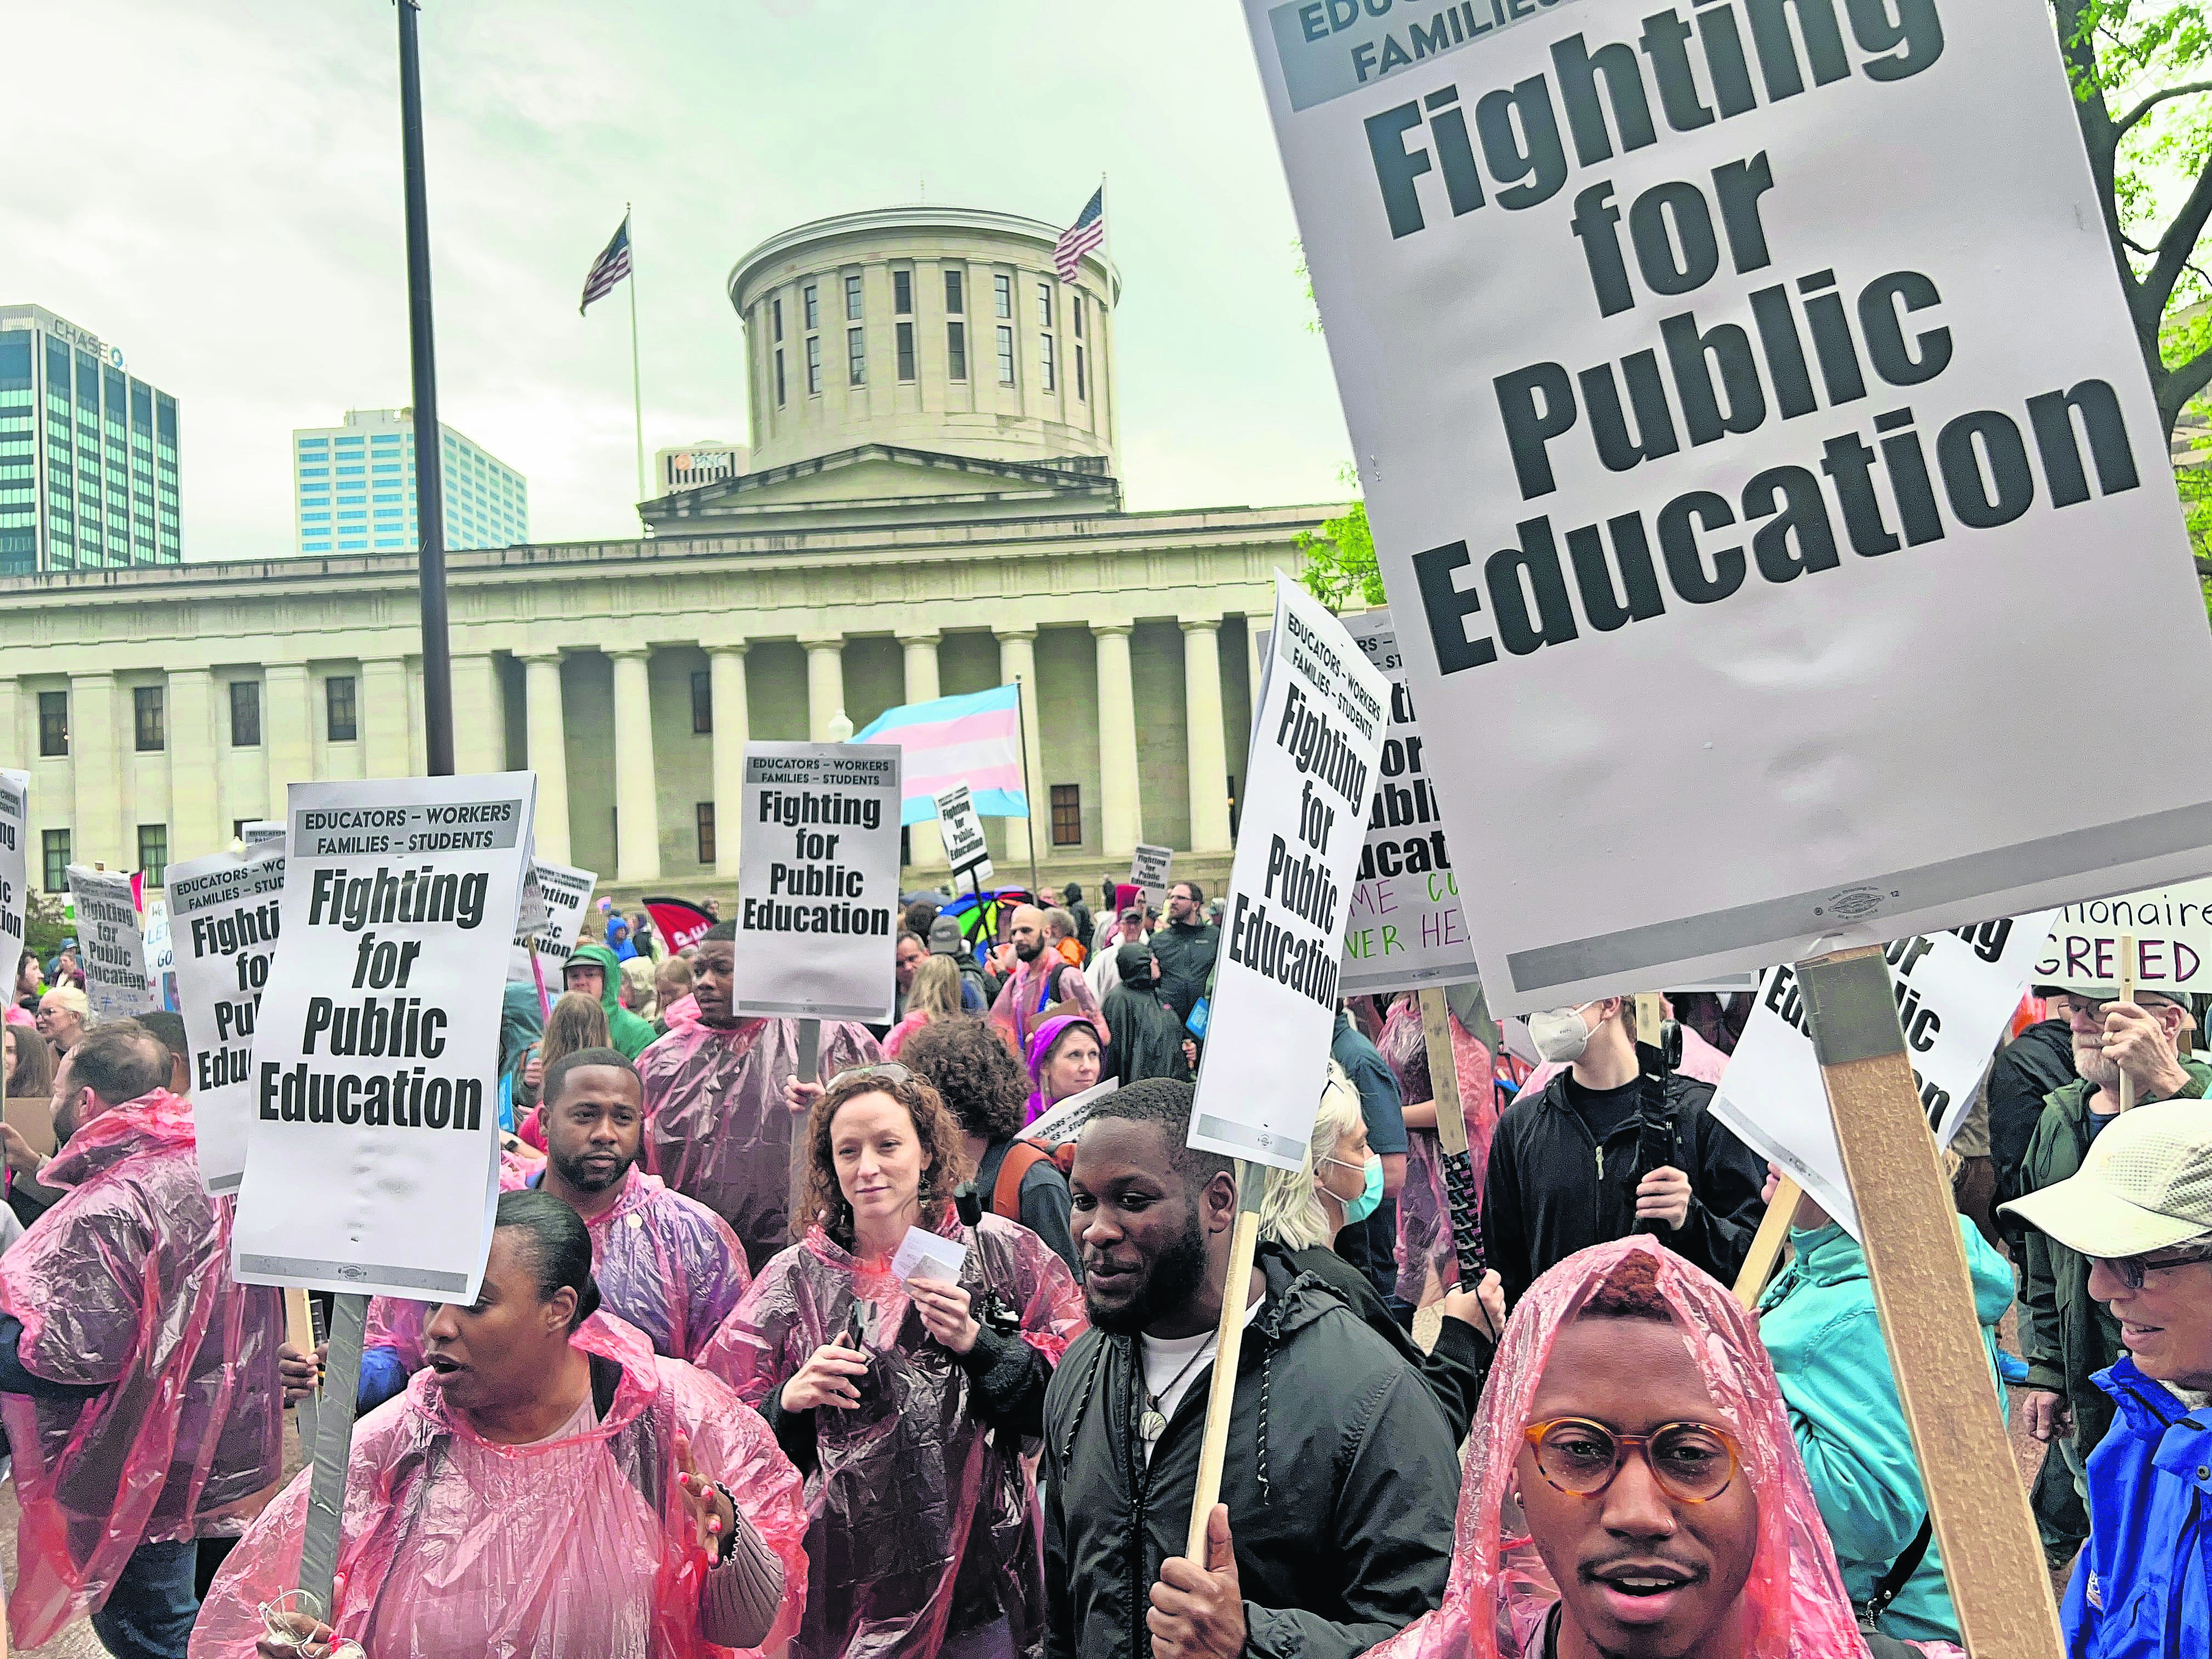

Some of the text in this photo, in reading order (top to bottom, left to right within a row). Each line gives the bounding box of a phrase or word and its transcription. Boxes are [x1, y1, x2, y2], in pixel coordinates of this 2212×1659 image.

[1298, 0, 1425, 43] EDU
[1351, 0, 1561, 84] FAMILIE
[1364, 0, 1945, 240] Fighting
[1570, 149, 1774, 318] for
[55, 319, 108, 359] CHASE
[1493, 267, 1953, 500] Public
[1410, 375, 2141, 676] Education
[1288, 612, 1341, 678] EDUCATORS
[1347, 672, 1381, 723] WORKERS
[1292, 647, 1331, 697] FAMILIES
[1338, 692, 1373, 741] STUDENTS
[753, 758, 820, 770] EDUCATORS
[833, 760, 889, 772] WORKERS
[1277, 681, 1367, 817] Fighting
[761, 771, 810, 784] FAMILIES
[823, 774, 880, 786] STUDENTS
[305, 809, 407, 830] EDUCATORS
[426, 804, 511, 823] WORKERS
[759, 791, 881, 830] Fighting
[1299, 780, 1335, 856] for
[317, 835, 389, 854] FAMILIES
[408, 831, 493, 851] STUDENTS
[795, 827, 840, 860] for
[177, 867, 249, 896] EDUCATORS
[188, 888, 240, 911] FAMILIES
[308, 865, 489, 929] Fighting
[770, 862, 864, 898] Public
[1264, 833, 1338, 935] Public
[81, 898, 133, 927] Fighting
[743, 898, 890, 936] Education
[236, 951, 274, 992] fo
[352, 932, 421, 989] for
[1228, 892, 1338, 1012] Education
[302, 997, 448, 1059] Public
[197, 1046, 252, 1092] Edu
[259, 1062, 483, 1131] Education
